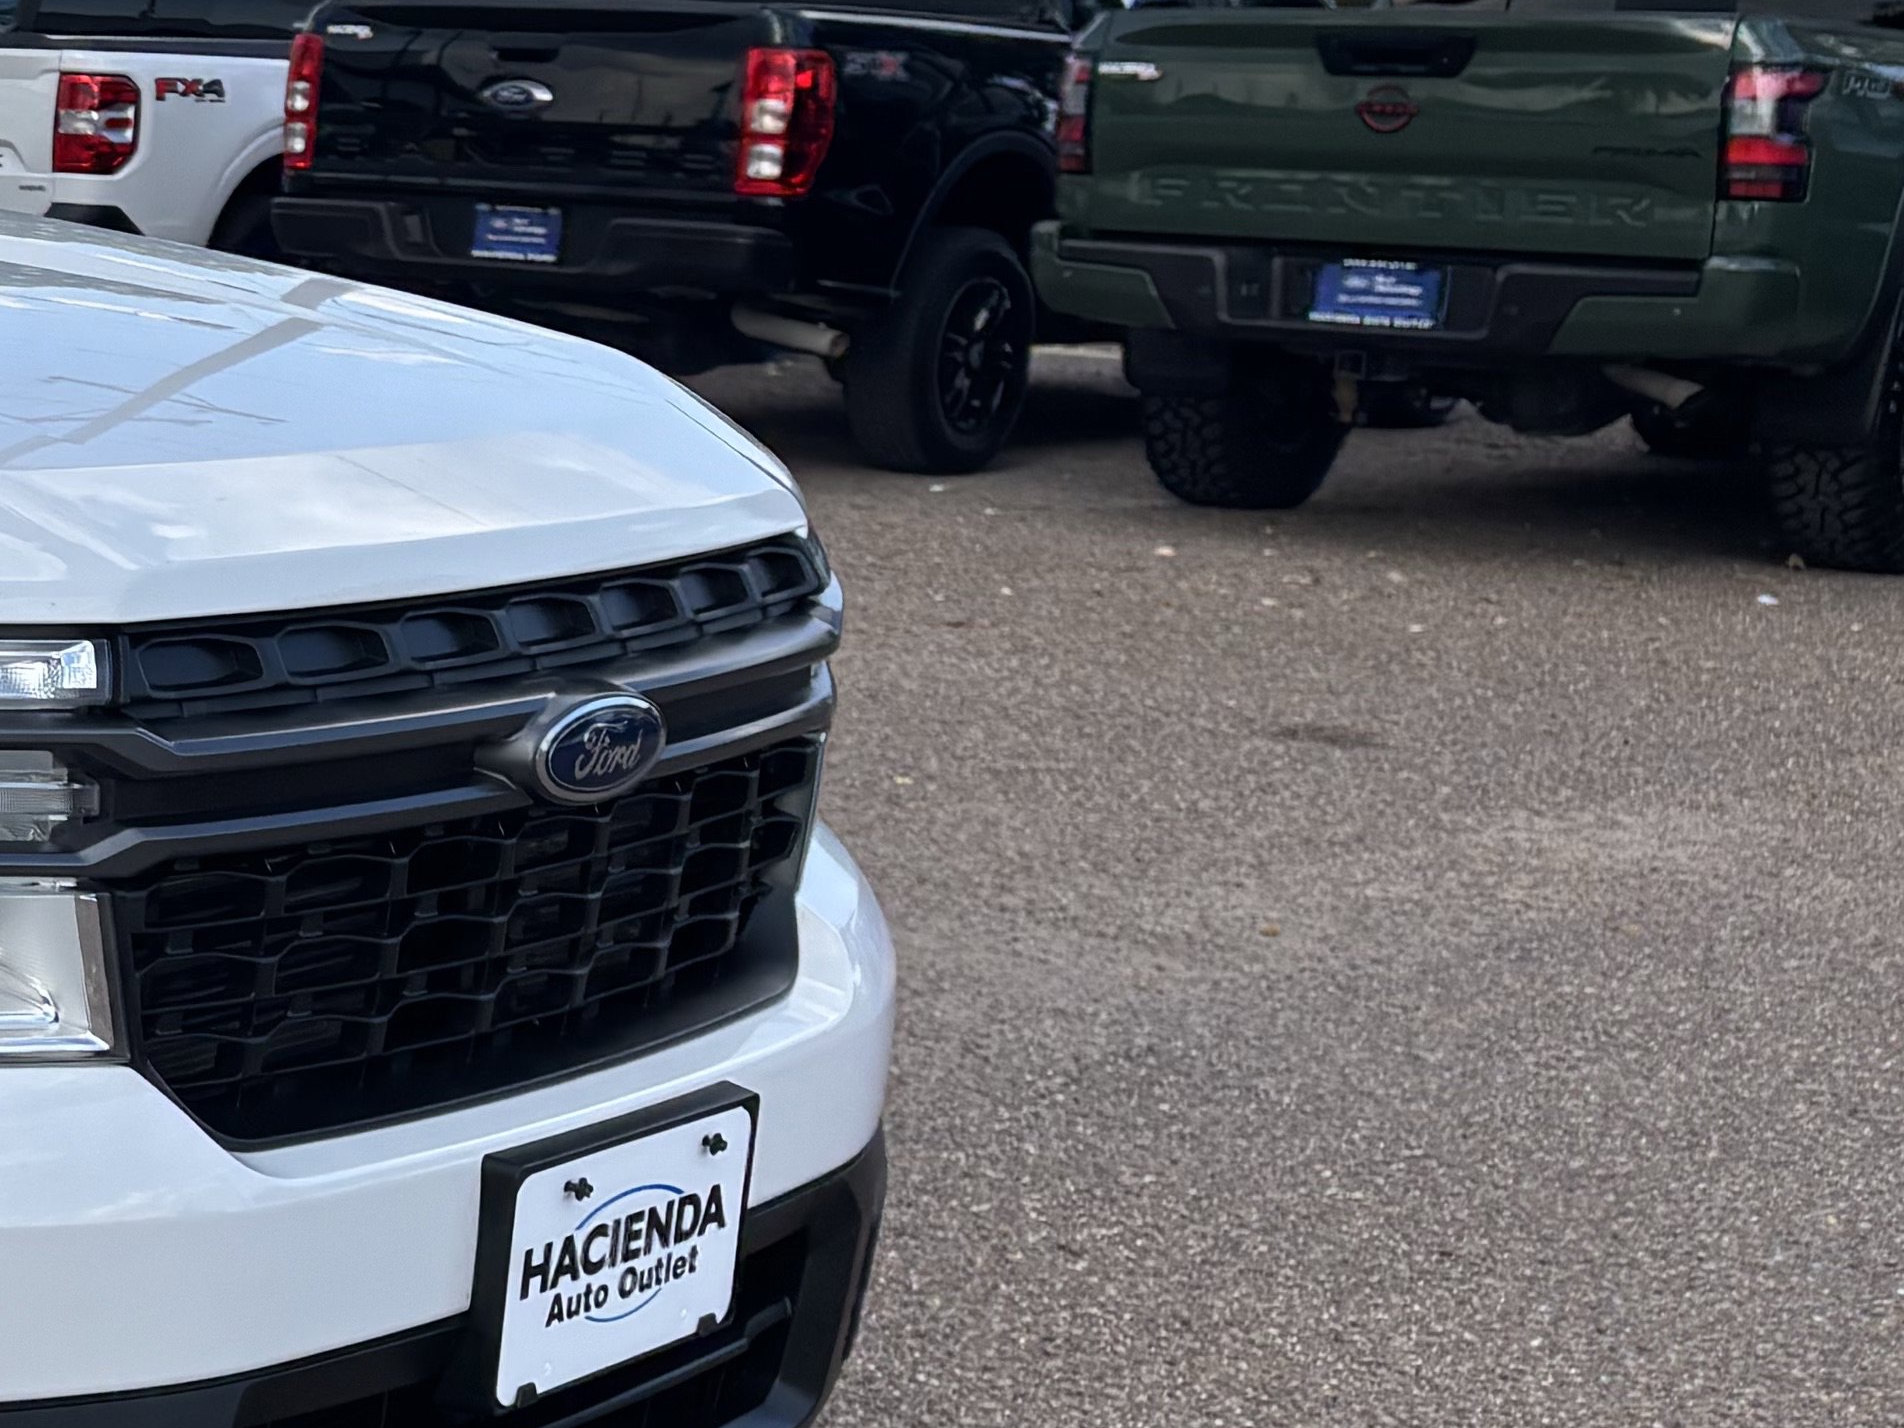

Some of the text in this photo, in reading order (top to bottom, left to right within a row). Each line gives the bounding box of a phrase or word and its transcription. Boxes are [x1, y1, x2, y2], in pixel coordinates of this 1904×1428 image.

[154, 77, 226, 101] FX4
[573, 720, 645, 781] Ford
[519, 1182, 726, 1301] HACIENDA
[545, 1244, 700, 1328] Auto Outlet
